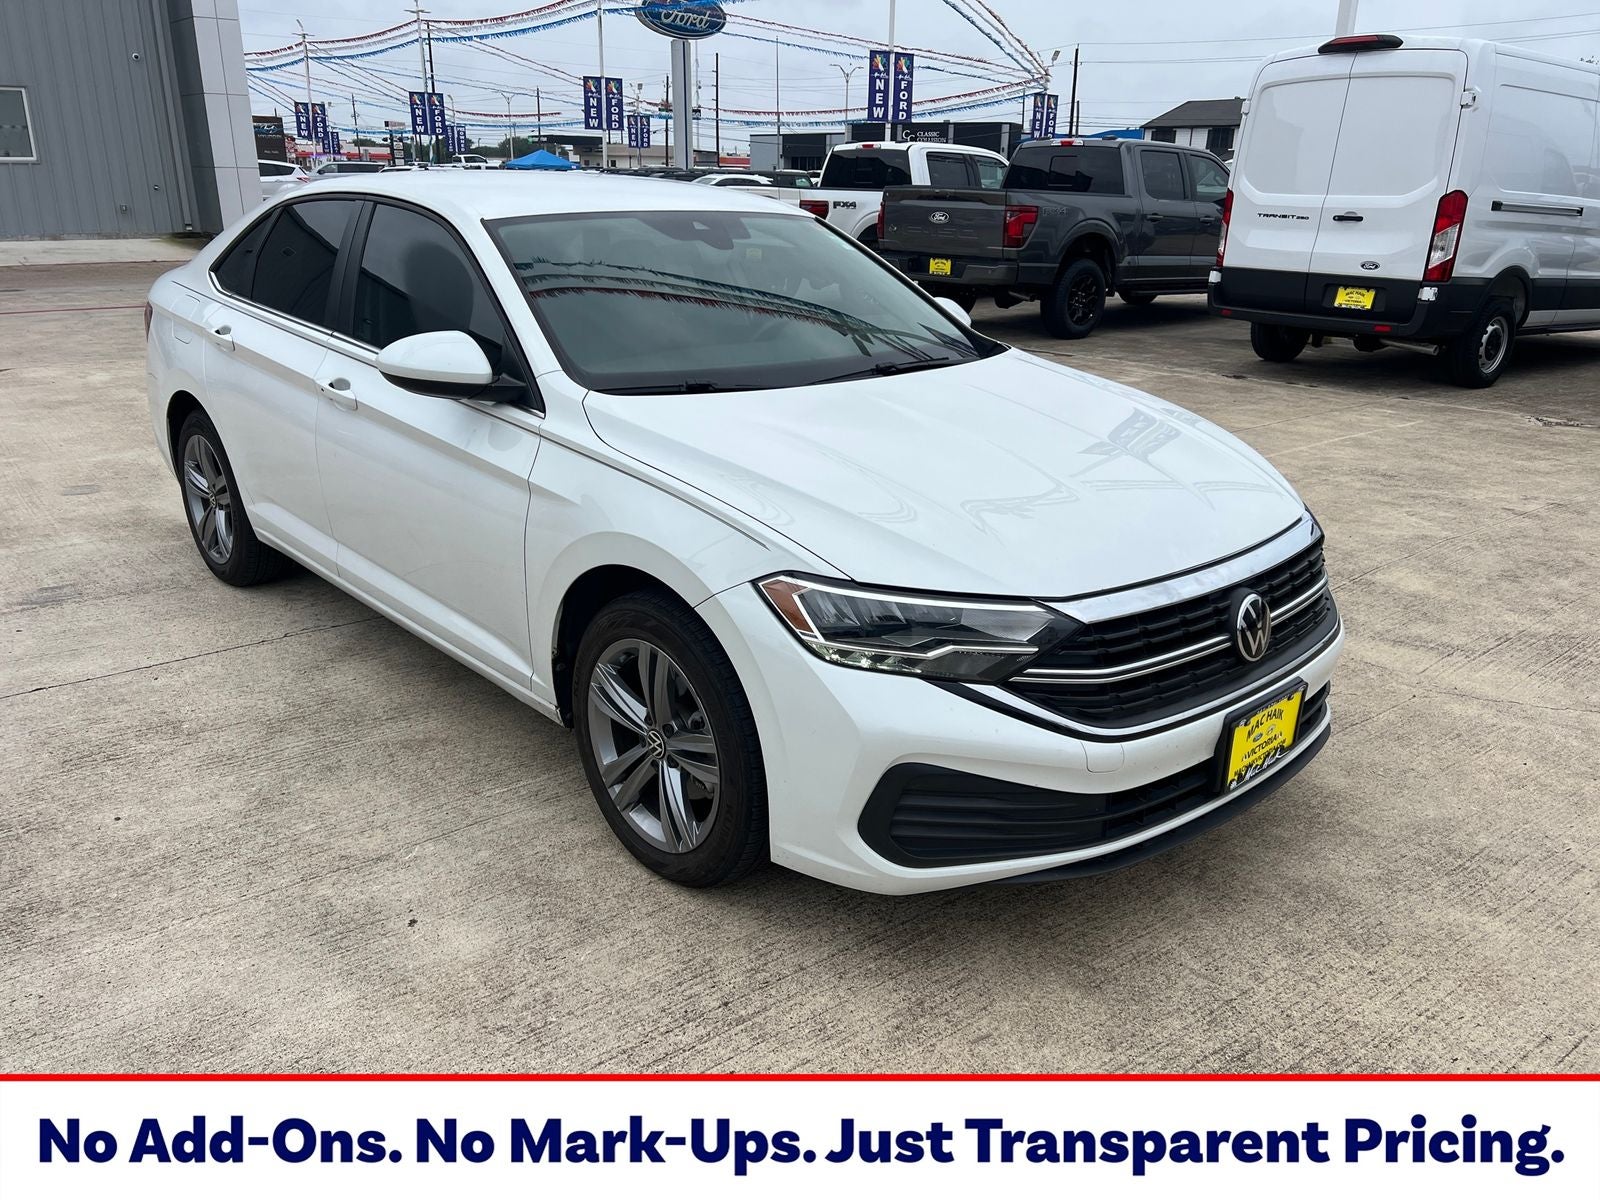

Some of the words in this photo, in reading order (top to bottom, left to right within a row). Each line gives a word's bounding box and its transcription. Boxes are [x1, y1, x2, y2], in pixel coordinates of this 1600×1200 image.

[660, 10, 711, 29] Ford
[873, 78, 884, 118] NEW
[898, 80, 908, 120] FORD
[300, 116, 308, 137] NEW
[415, 109, 425, 133] NEW
[434, 110, 442, 134] FORD
[589, 98, 599, 128] NEW
[611, 99, 619, 129] FORD
[1034, 111, 1042, 138] NEW
[316, 117, 324, 138] FORD
[1246, 714, 1265, 742] MAC
[1266, 708, 1284, 723] HAIK
